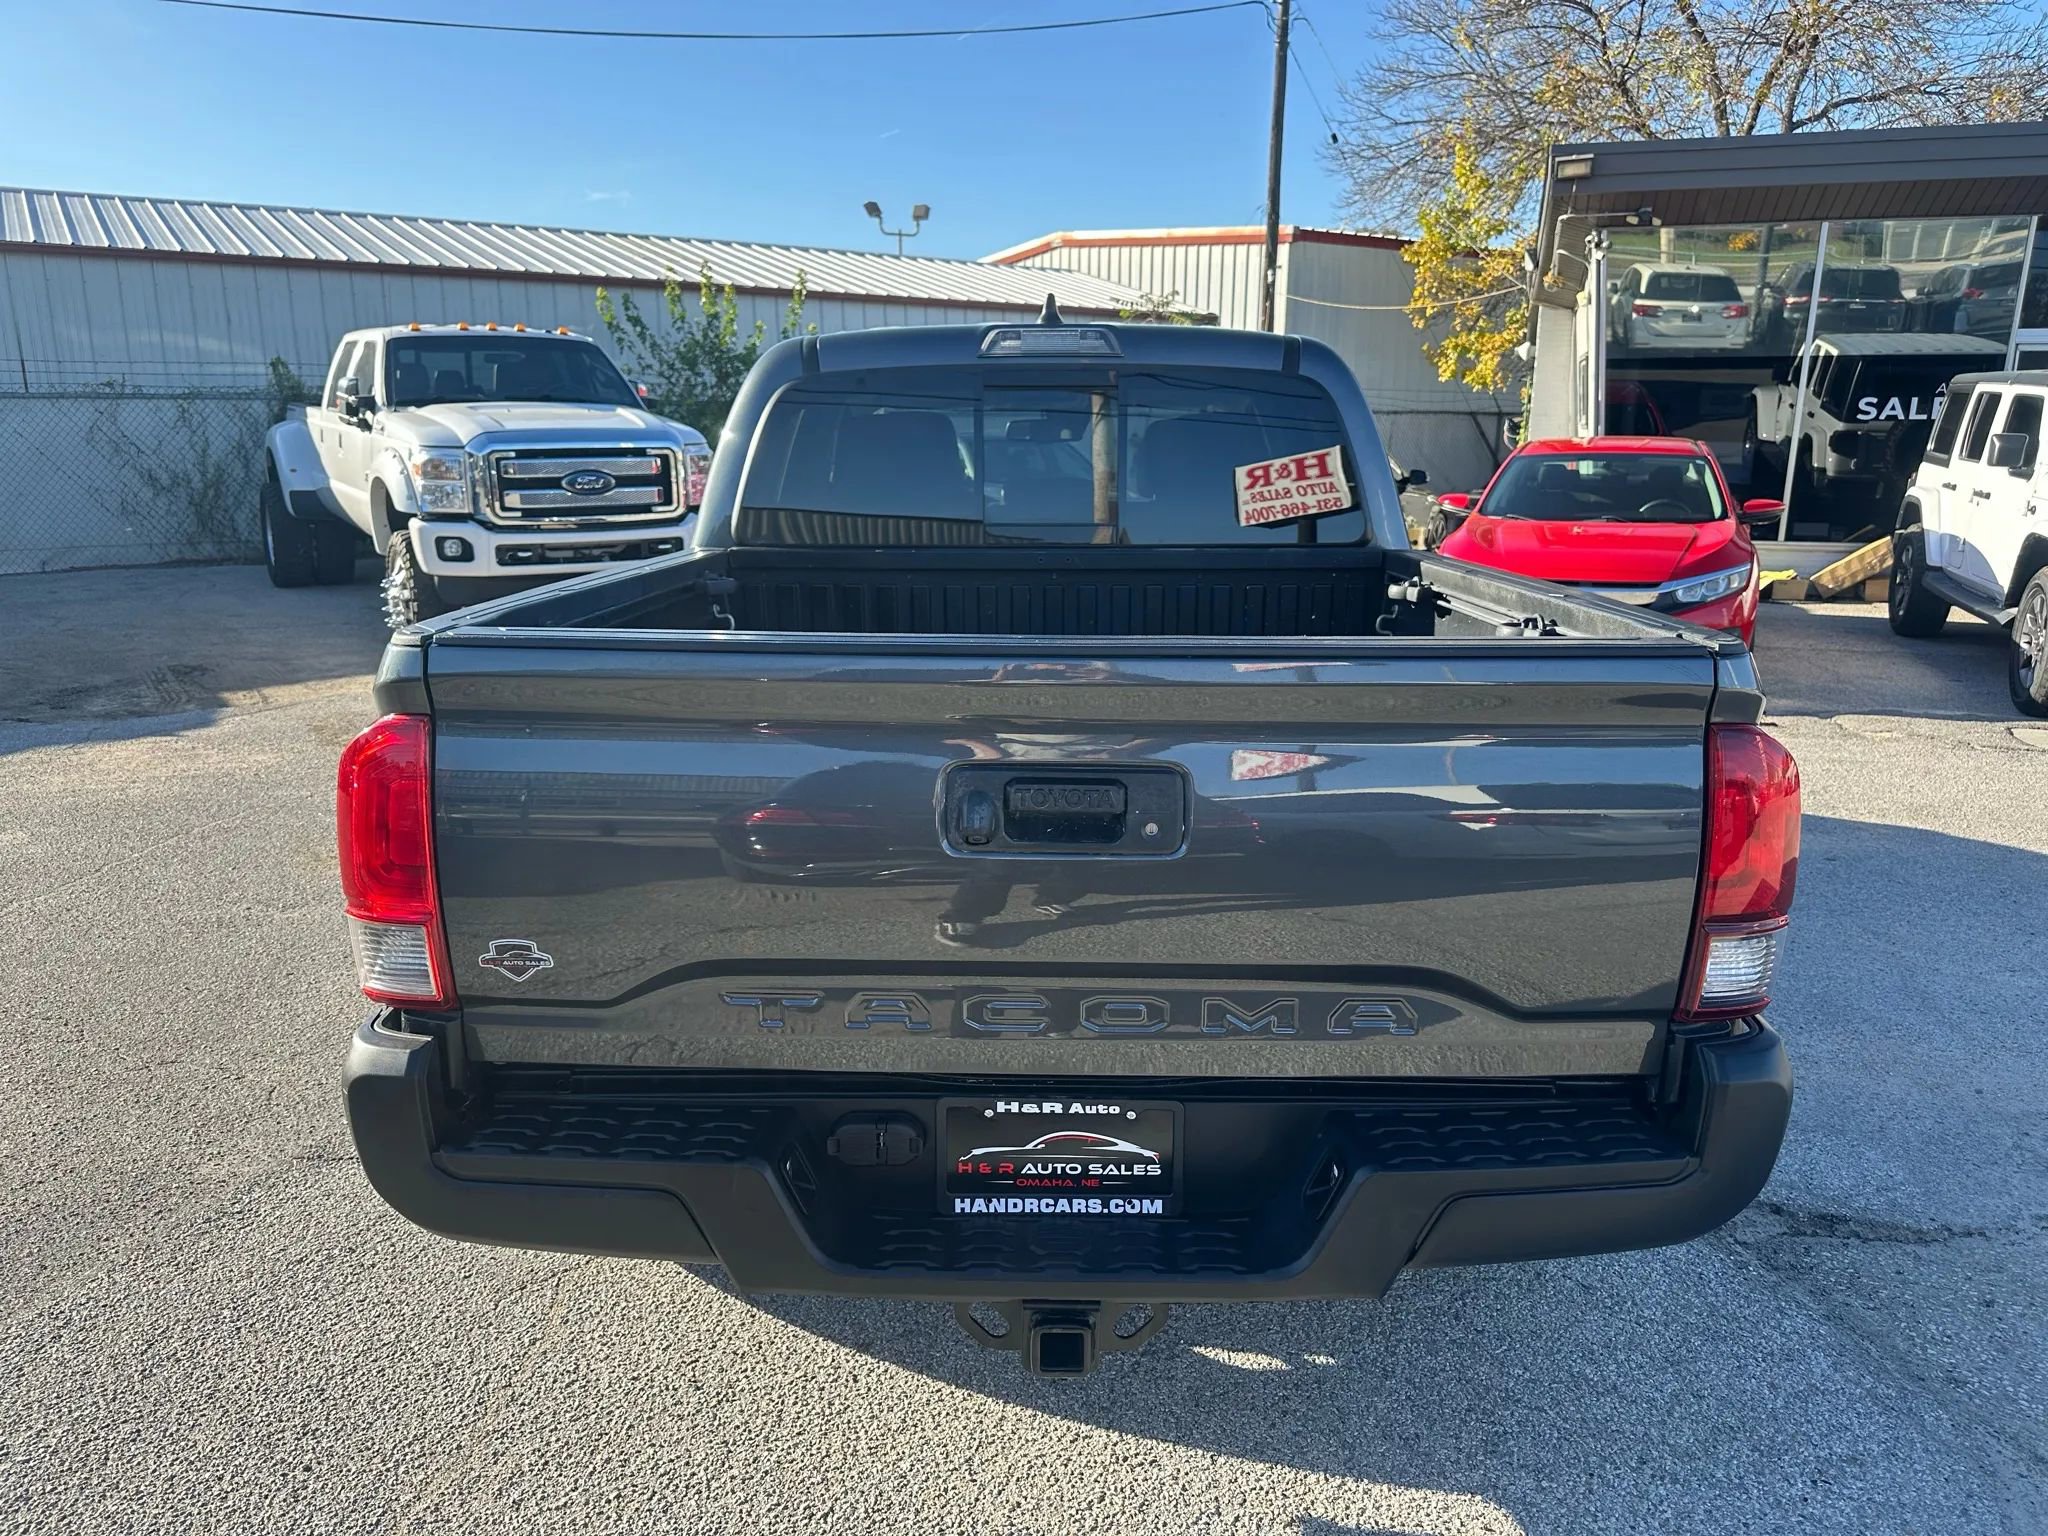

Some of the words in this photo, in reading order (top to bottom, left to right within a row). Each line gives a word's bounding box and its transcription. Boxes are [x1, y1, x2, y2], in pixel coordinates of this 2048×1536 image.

[575, 476, 605, 489] Ford
[1015, 788, 1116, 809] TOYOTA
[719, 991, 1420, 1037] TACOMA
[996, 1101, 1064, 1114] H&R
[1068, 1102, 1121, 1115] Auto
[957, 1162, 974, 1174] H
[999, 1163, 1015, 1174] R
[1020, 1163, 1082, 1175] AUTO
[1088, 1163, 1162, 1176] SALES
[1016, 1178, 1077, 1187] OMAHA,
[1081, 1178, 1100, 1187] NE
[954, 1198, 1163, 1214] HANDRCARS.COM
